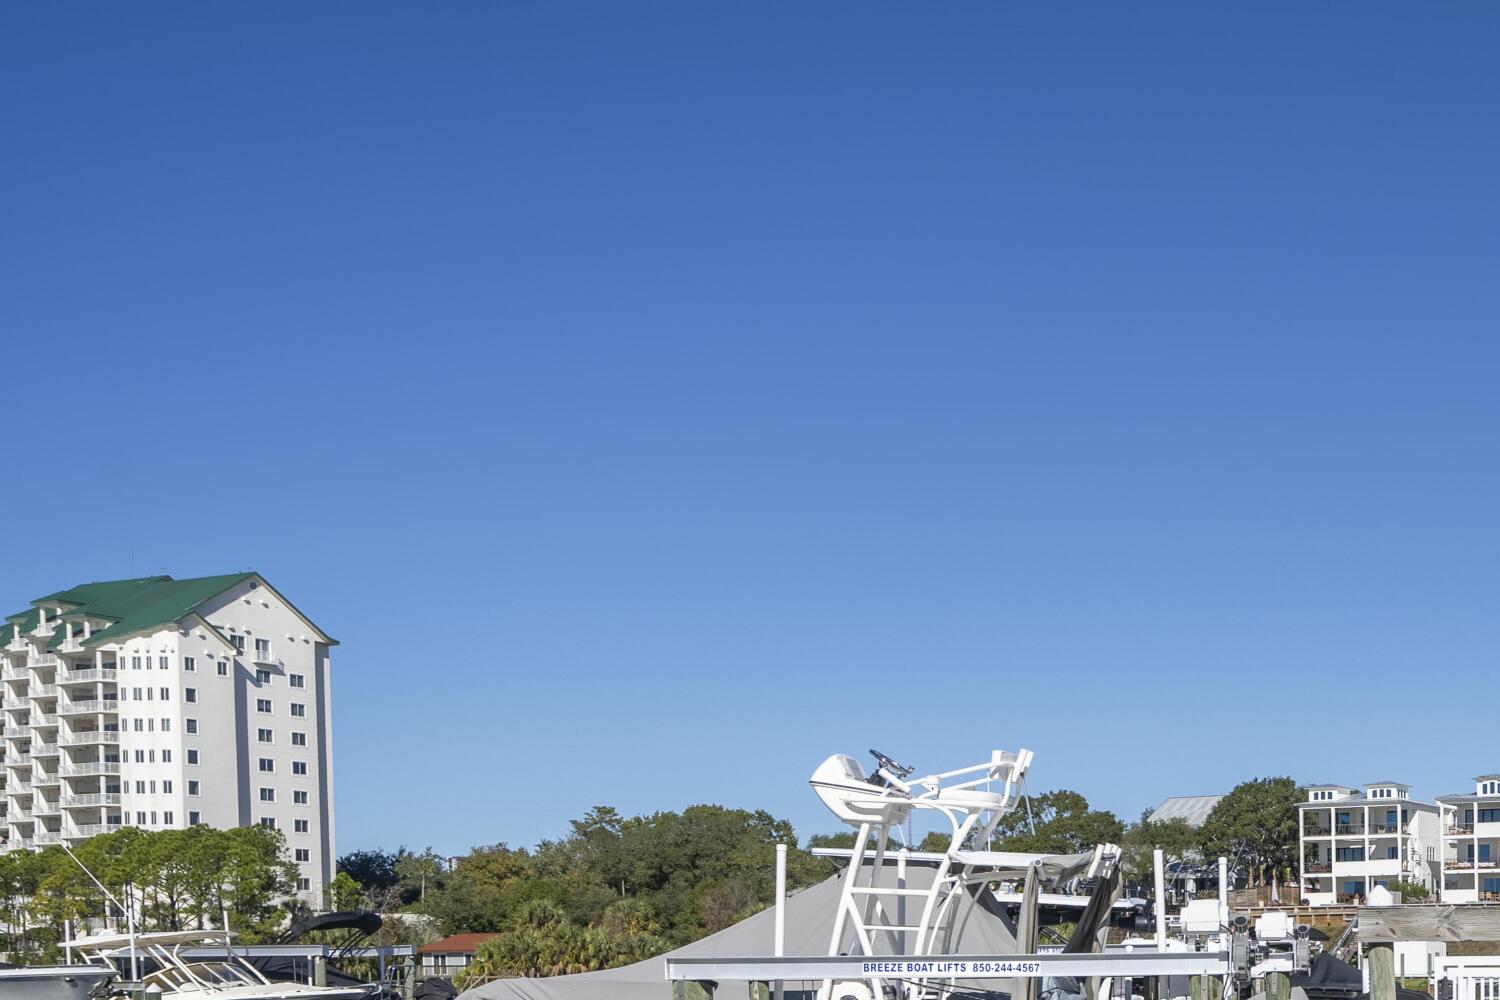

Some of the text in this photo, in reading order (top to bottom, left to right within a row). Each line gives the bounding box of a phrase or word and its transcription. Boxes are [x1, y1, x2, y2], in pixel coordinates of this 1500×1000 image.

[863, 963, 1040, 973] BREEZE BOAT LIFTS 850-244-4567
